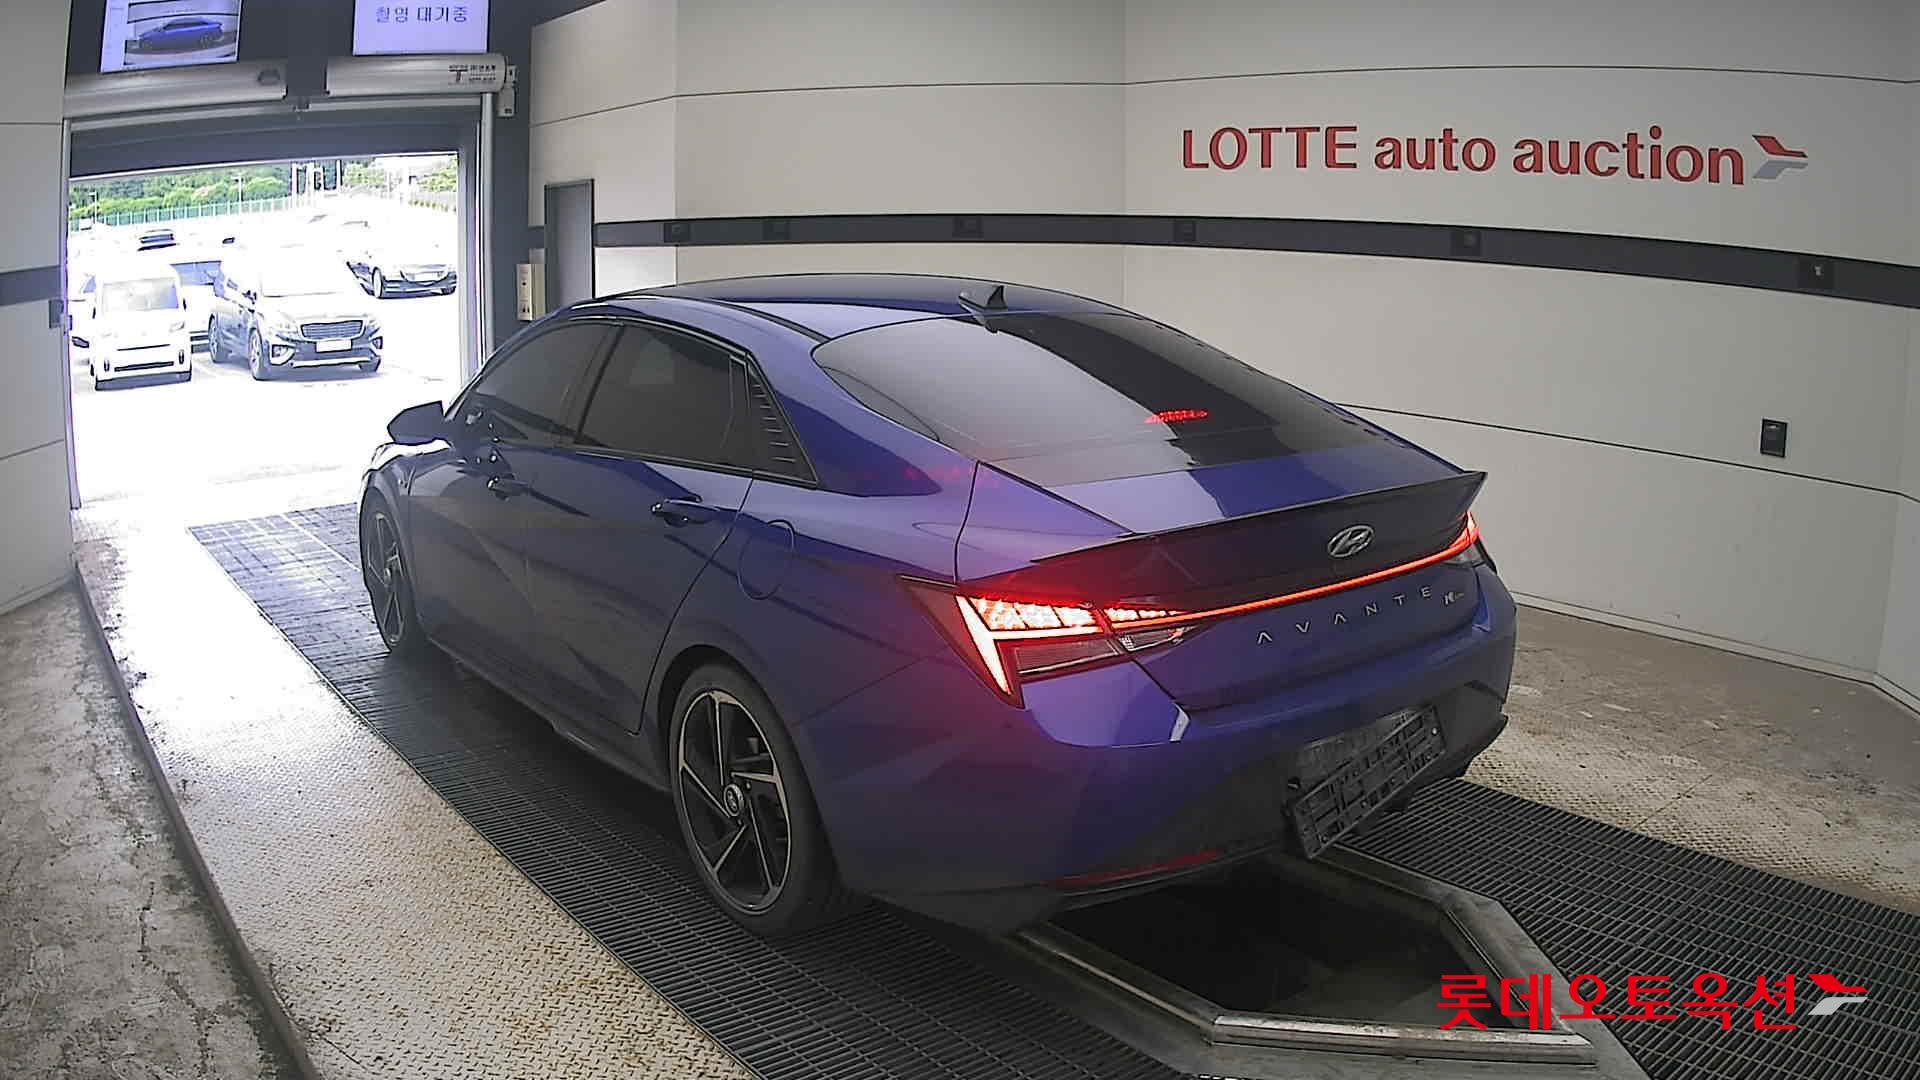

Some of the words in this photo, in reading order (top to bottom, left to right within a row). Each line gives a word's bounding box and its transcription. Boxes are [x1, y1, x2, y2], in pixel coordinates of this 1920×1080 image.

[417, 6, 467, 23] 대기중
[1183, 126, 1357, 170] LOTTE
[1374, 128, 1496, 172] auto
[1512, 125, 1744, 185] auction
[1256, 585, 1433, 645] AVANTE
